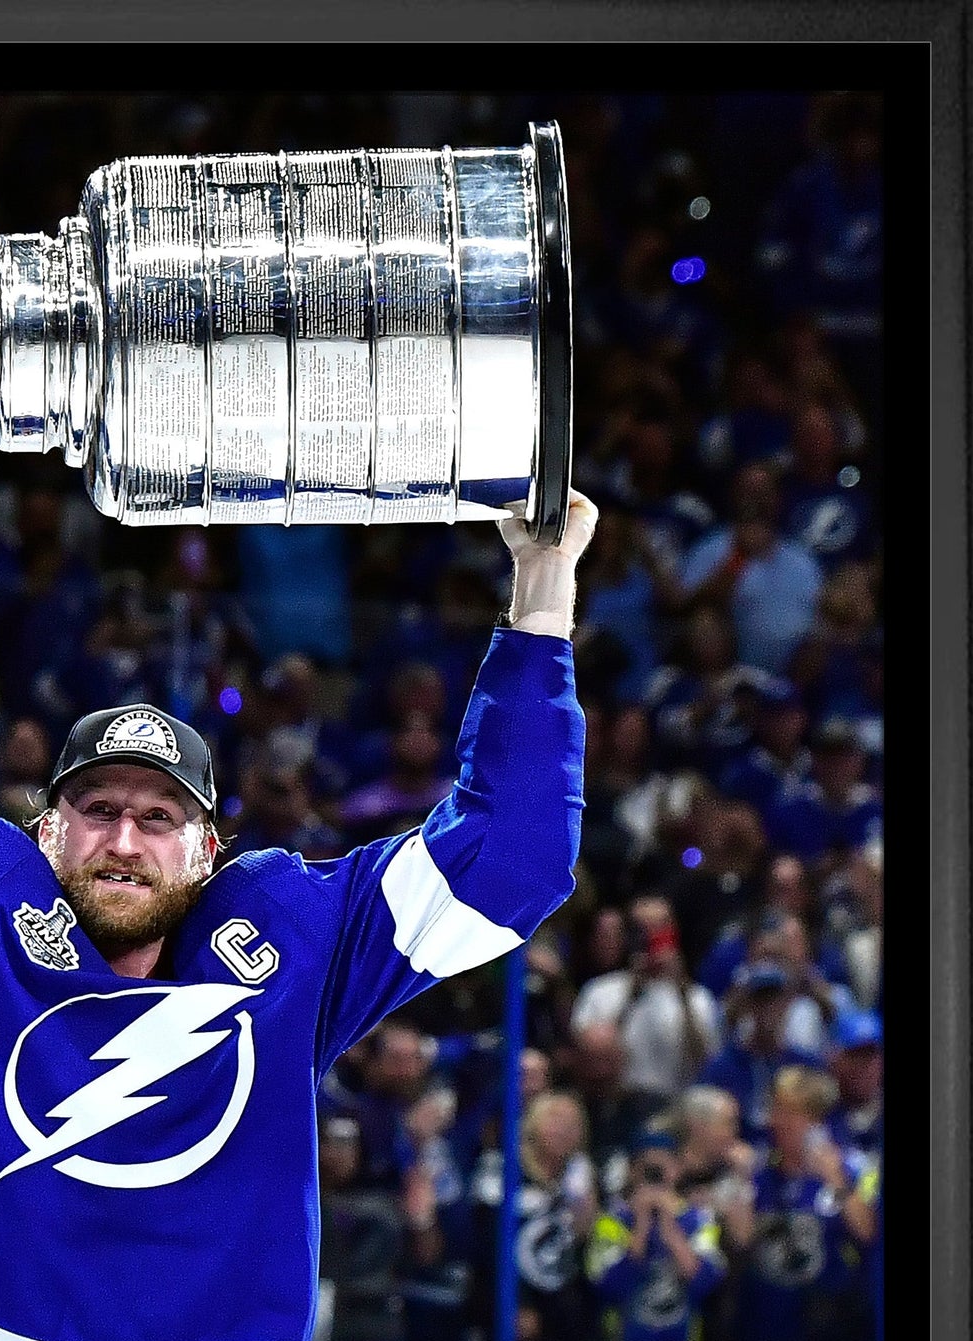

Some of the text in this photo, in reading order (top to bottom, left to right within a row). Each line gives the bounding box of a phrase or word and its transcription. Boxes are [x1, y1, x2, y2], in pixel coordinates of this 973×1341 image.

[99, 739, 177, 761] CHAMPIONS
[19, 909, 74, 966] FINAL
[212, 918, 280, 985] C
